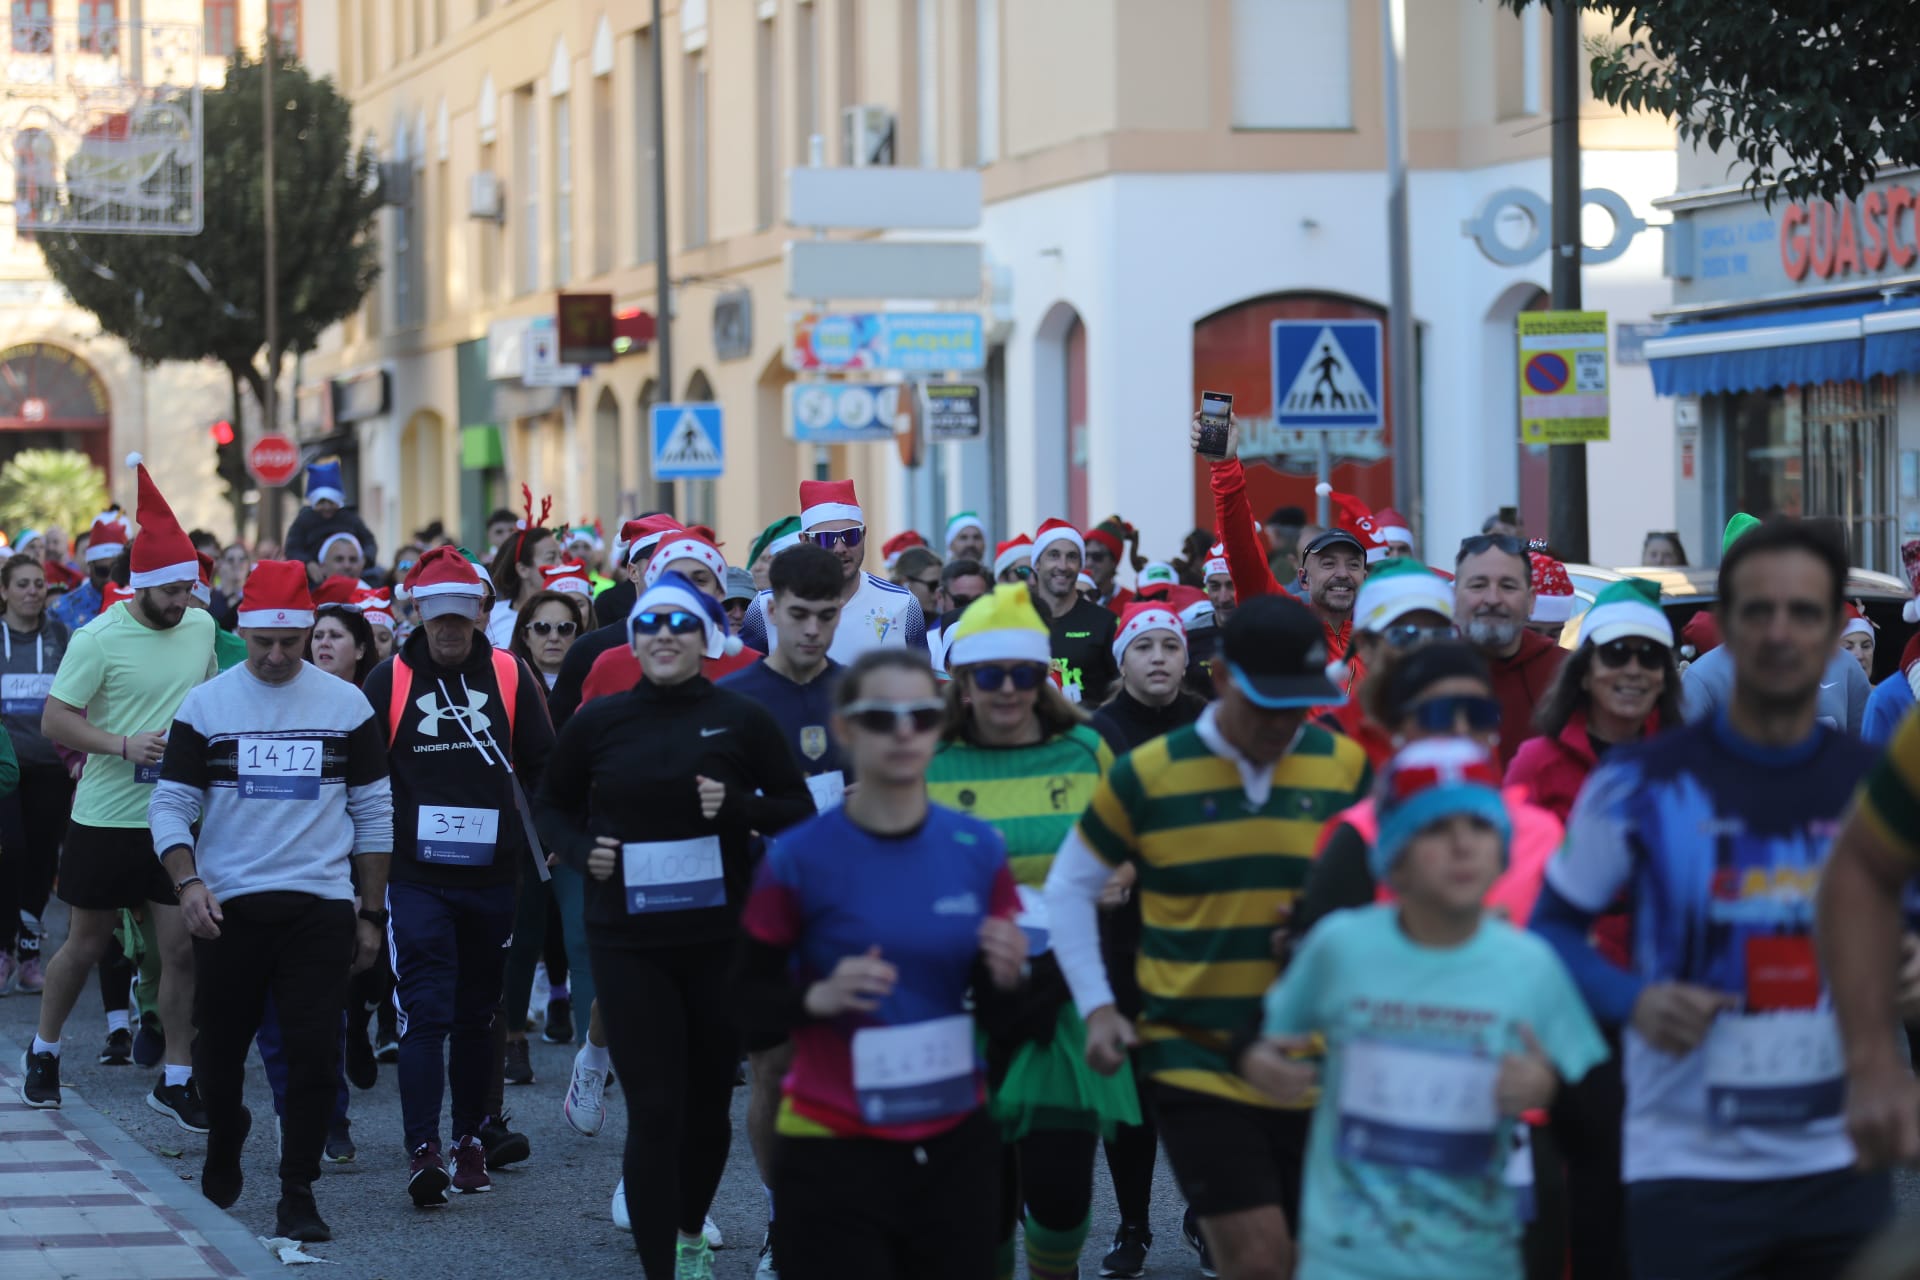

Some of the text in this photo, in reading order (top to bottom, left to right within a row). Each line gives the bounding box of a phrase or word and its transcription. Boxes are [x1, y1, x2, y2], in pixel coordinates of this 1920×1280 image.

[1780, 184, 1920, 282] GUASC
[254, 449, 294, 466] STOP
[247, 745, 316, 772] 1412
[413, 742, 450, 753] UNDER
[432, 813, 485, 836] 374
